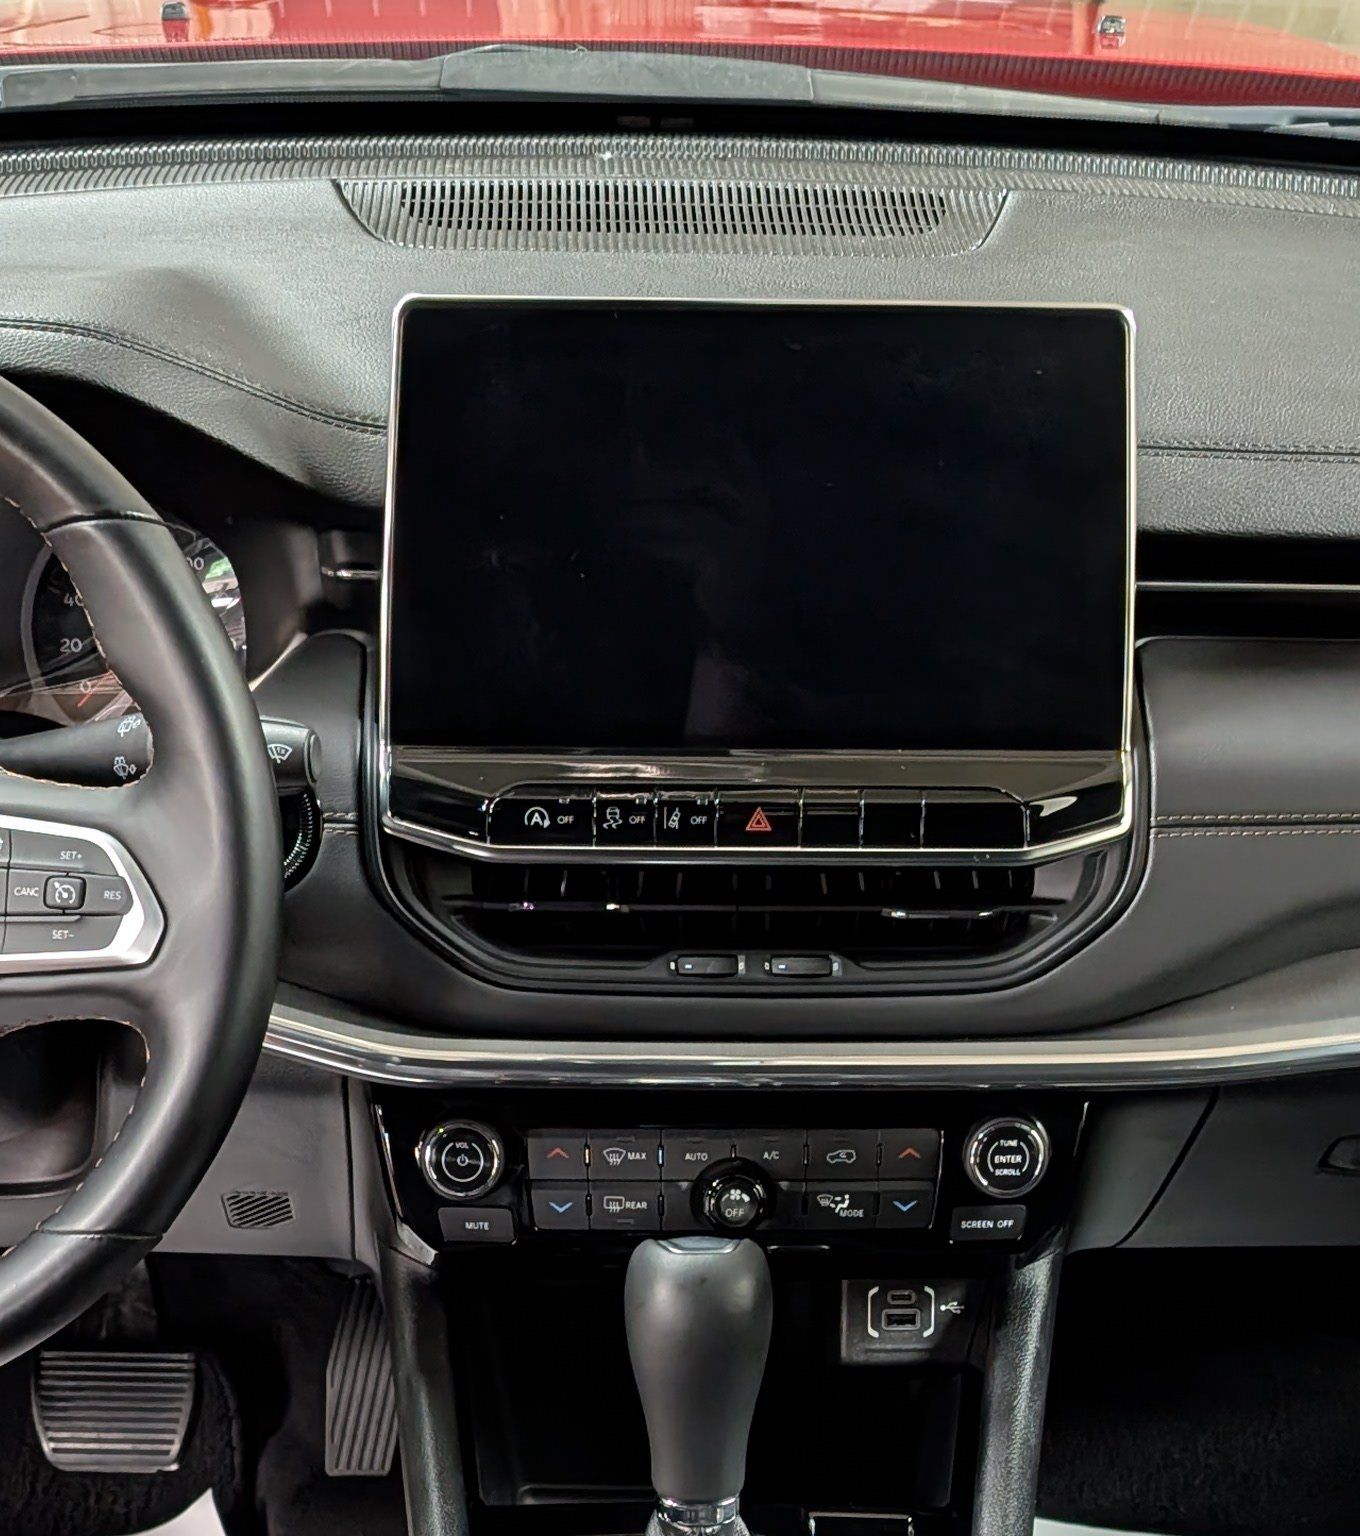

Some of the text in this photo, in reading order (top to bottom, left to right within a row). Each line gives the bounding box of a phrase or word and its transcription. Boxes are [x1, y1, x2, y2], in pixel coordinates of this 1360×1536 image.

[59, 638, 83, 653] 20
[557, 815, 574, 825] OFF
[629, 815, 646, 825] OFF
[690, 815, 708, 825] OFF
[60, 850, 83, 861] SET+
[14, 886, 40, 898] CANC
[103, 890, 122, 900] RES
[455, 1141, 469, 1149] VOL
[1000, 1139, 1018, 1147] TUNE
[627, 1151, 647, 1161] MAX
[684, 1152, 708, 1161] AUTO
[763, 1151, 780, 1160] A/C
[994, 1155, 1022, 1163] ENTER
[994, 1168, 1020, 1176] SCROLL
[625, 1201, 648, 1210] REAR
[724, 1208, 745, 1218] OFF
[840, 1209, 865, 1218] MODE
[465, 1221, 490, 1231] MUTE
[961, 1220, 1015, 1230] SCREEN OFF
